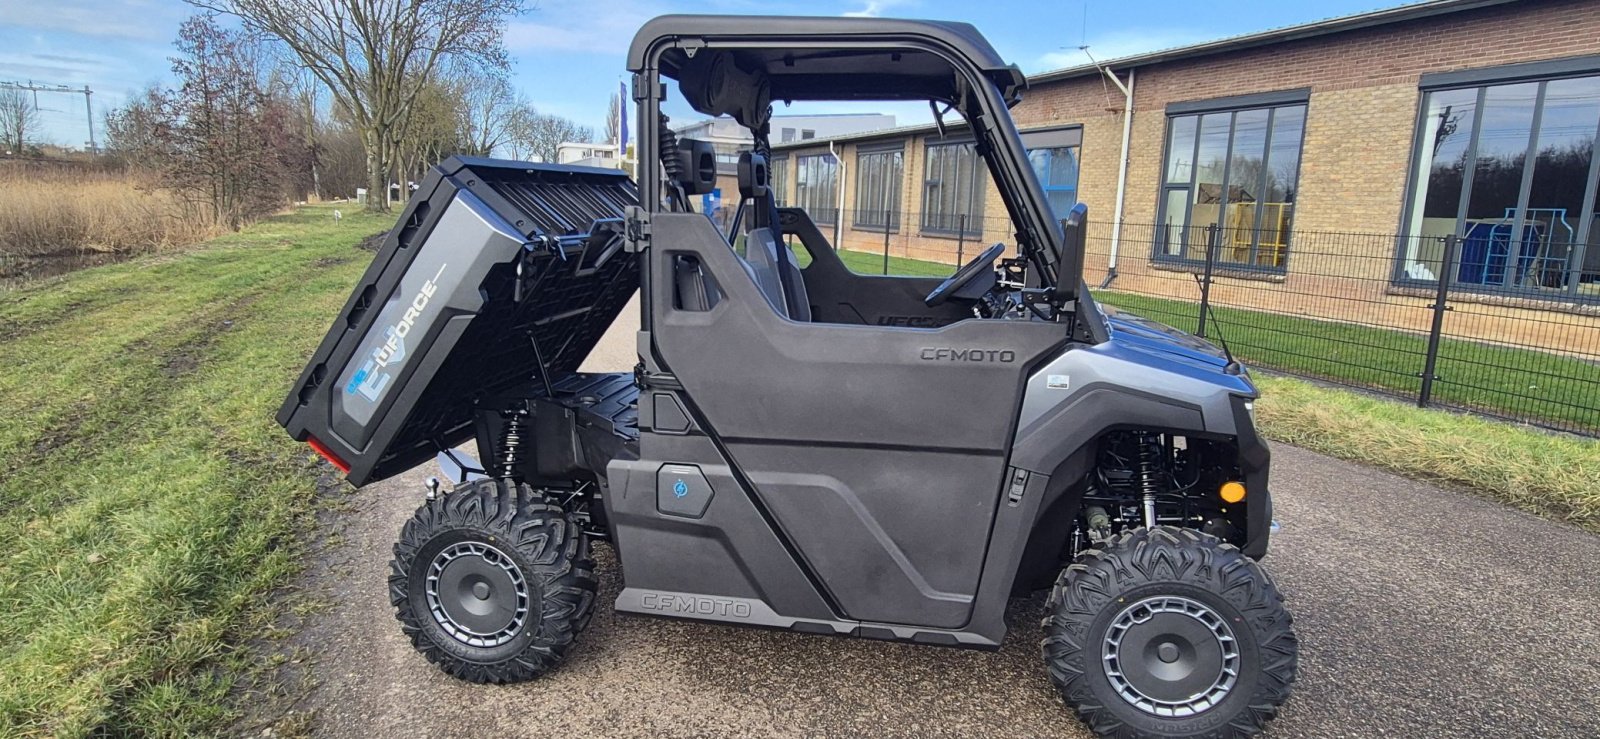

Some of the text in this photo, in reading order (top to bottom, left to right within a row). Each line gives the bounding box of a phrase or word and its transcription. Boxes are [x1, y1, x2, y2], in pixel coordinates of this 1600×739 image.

[375, 280, 437, 367] UFORCE
[920, 346, 1015, 363] CFMOTO
[641, 593, 752, 618] CFMOTO
